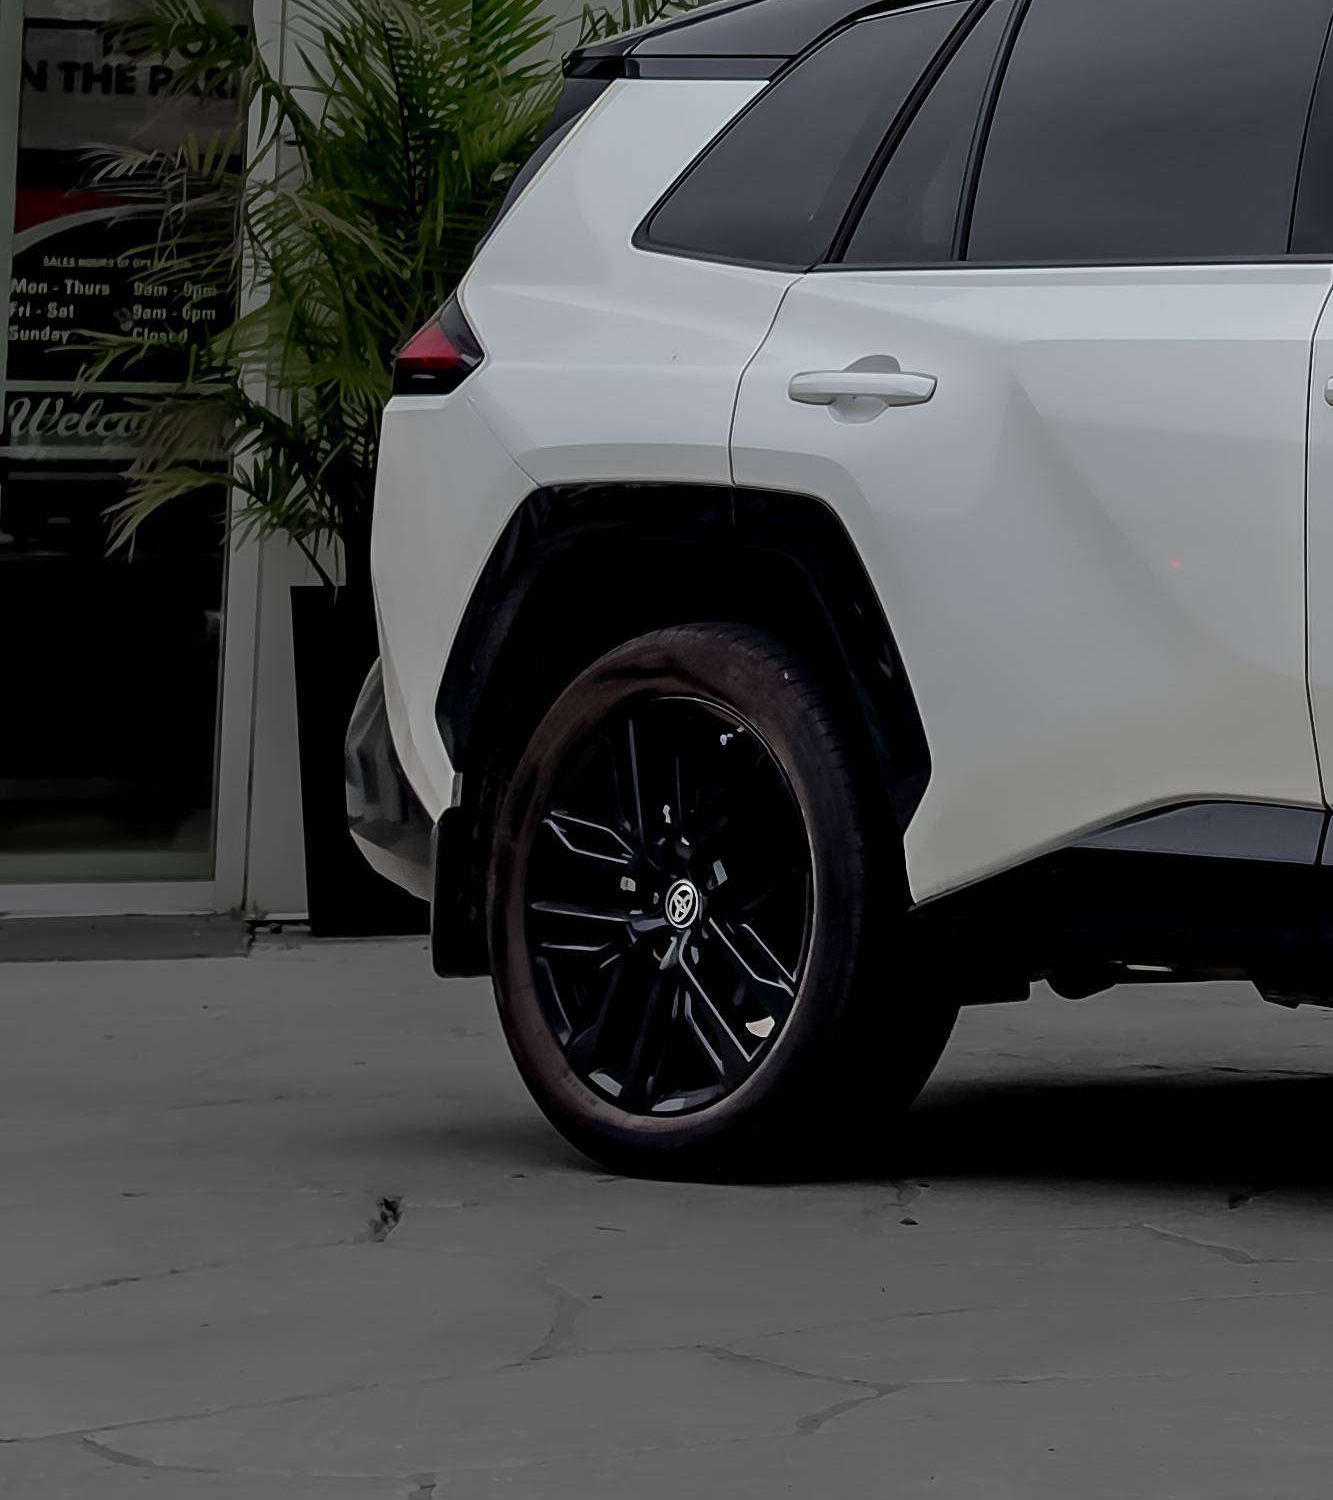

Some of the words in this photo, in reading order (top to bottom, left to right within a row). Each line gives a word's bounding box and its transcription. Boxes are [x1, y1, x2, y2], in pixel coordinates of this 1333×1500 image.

[57, 61, 135, 95] THE
[10, 277, 47, 295] Mon
[63, 278, 111, 296] Thurs
[46, 300, 74, 318] Sat
[9, 324, 70, 345] Sunday
